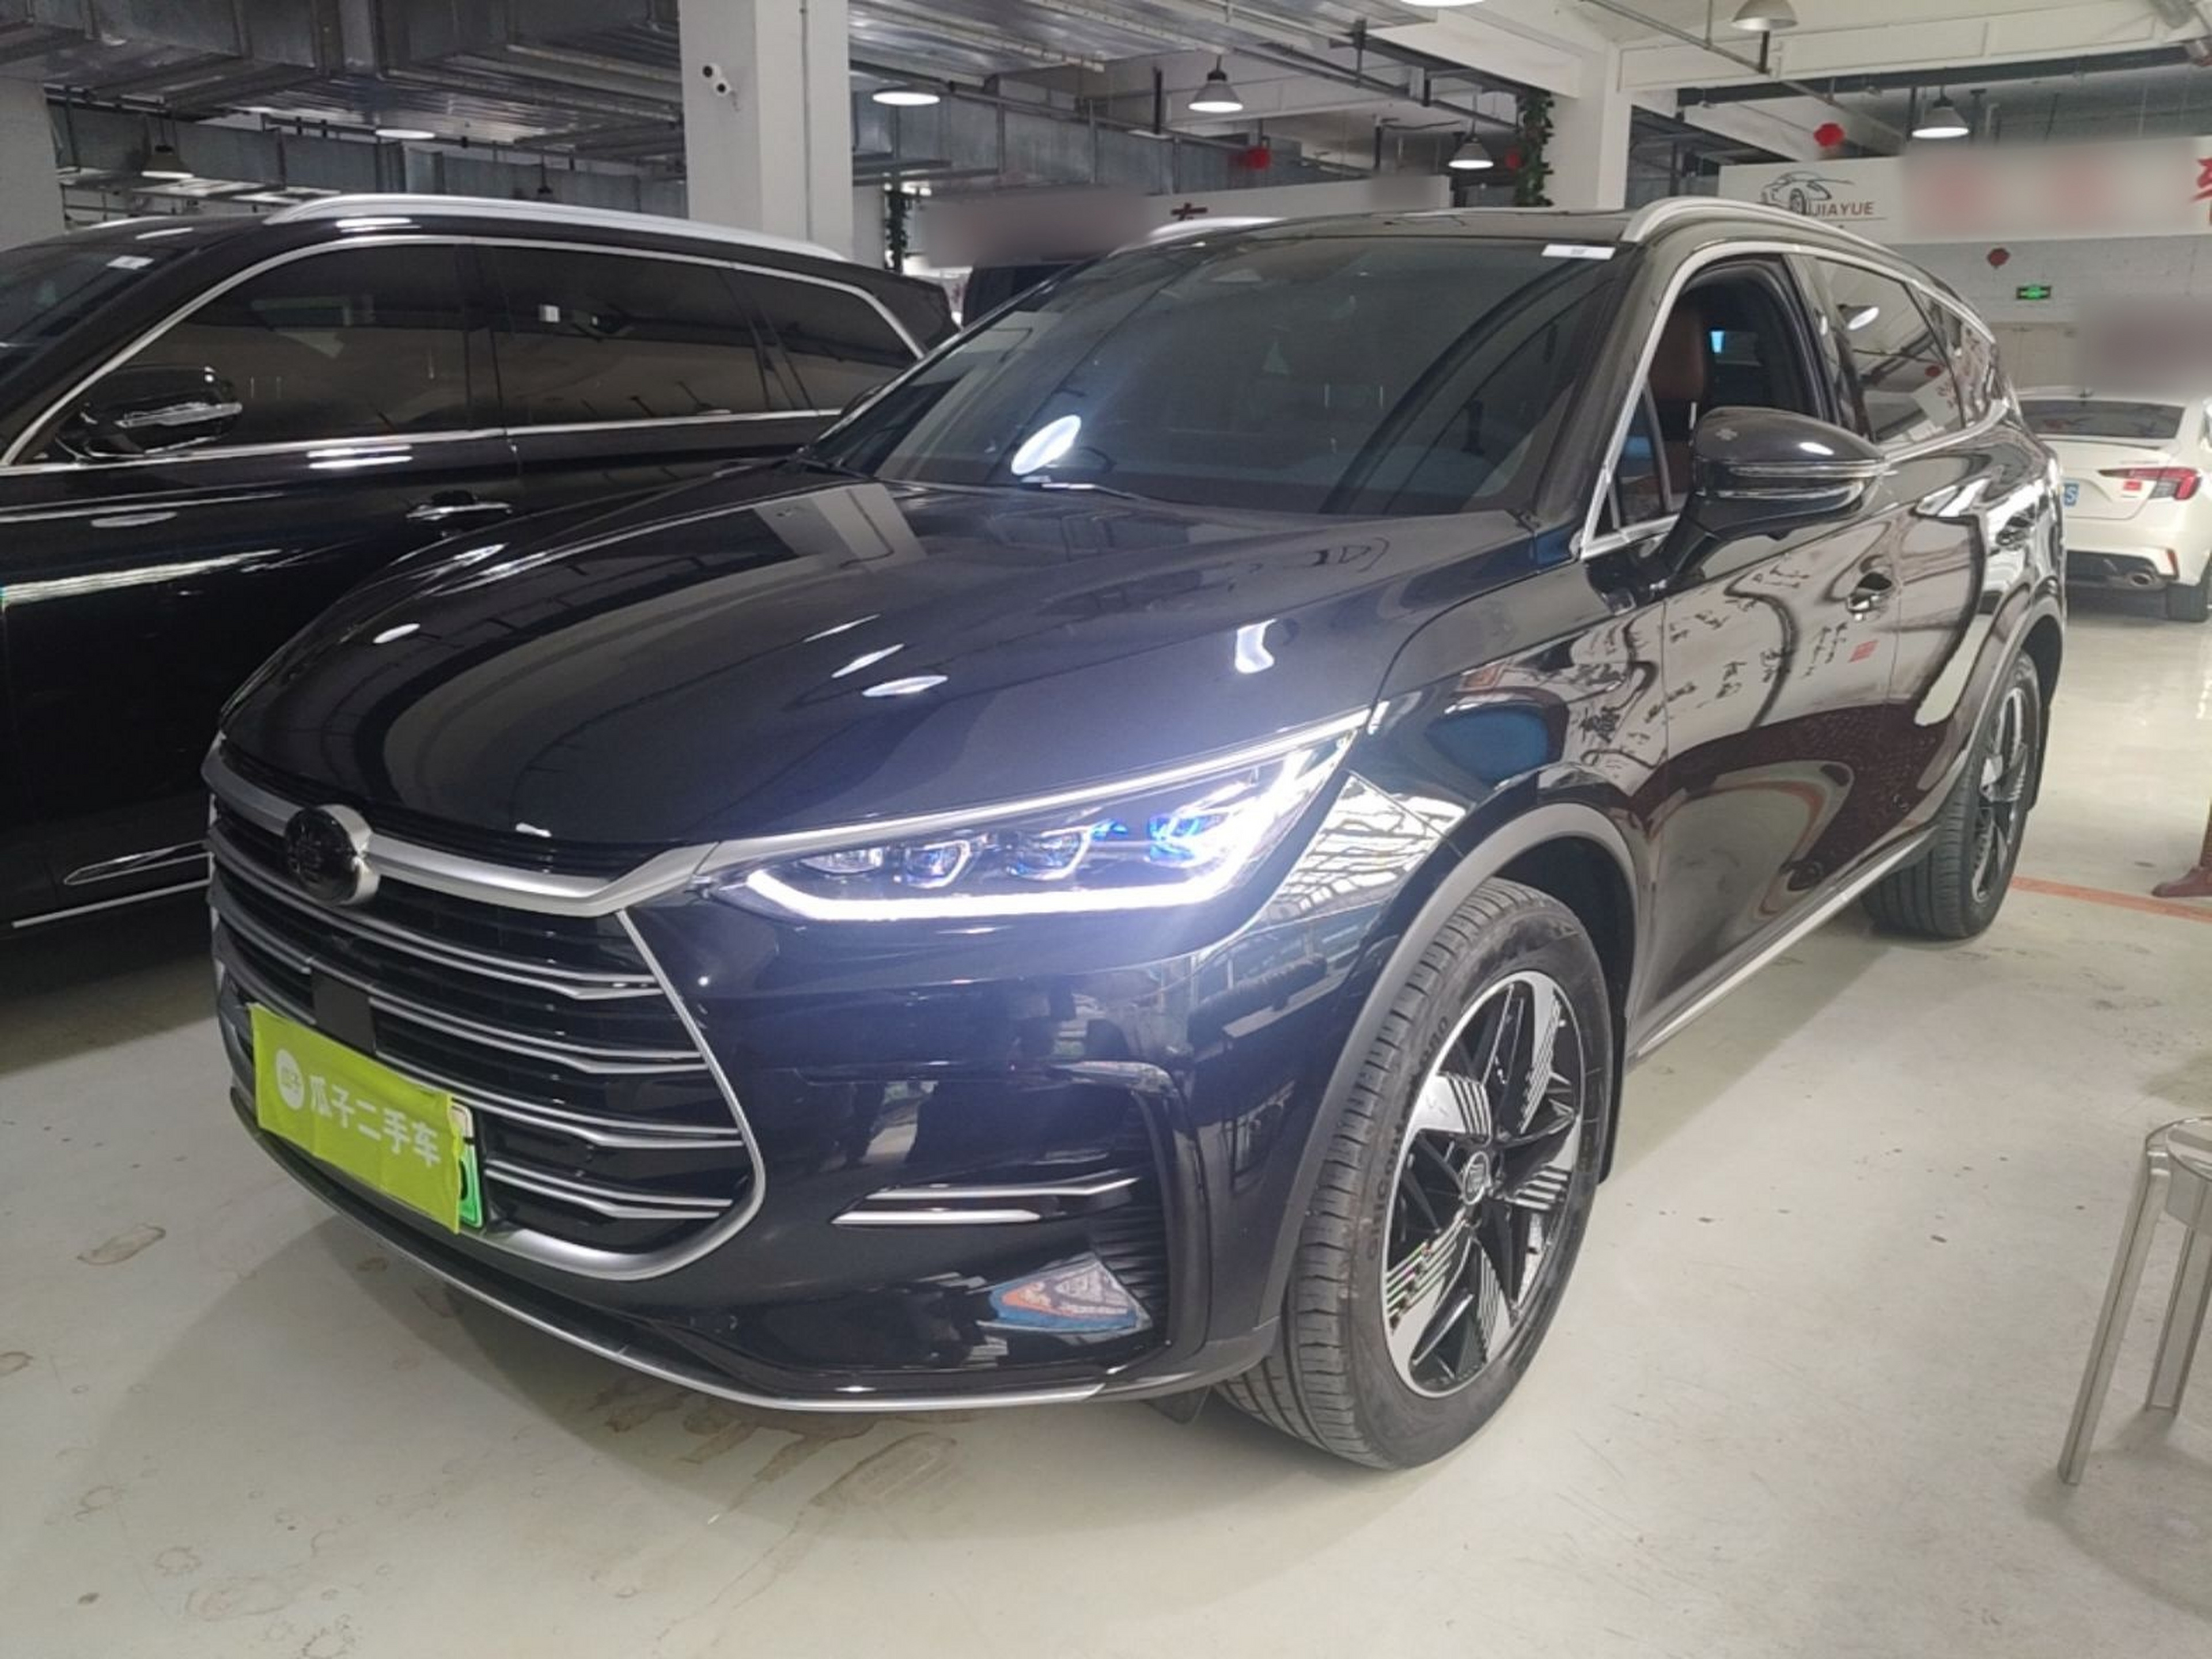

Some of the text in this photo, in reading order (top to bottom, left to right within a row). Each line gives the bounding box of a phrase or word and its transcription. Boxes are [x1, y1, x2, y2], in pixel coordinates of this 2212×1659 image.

[1813, 202, 1874, 216] JIAYUE
[309, 1075, 441, 1168] 瓜子二手车
